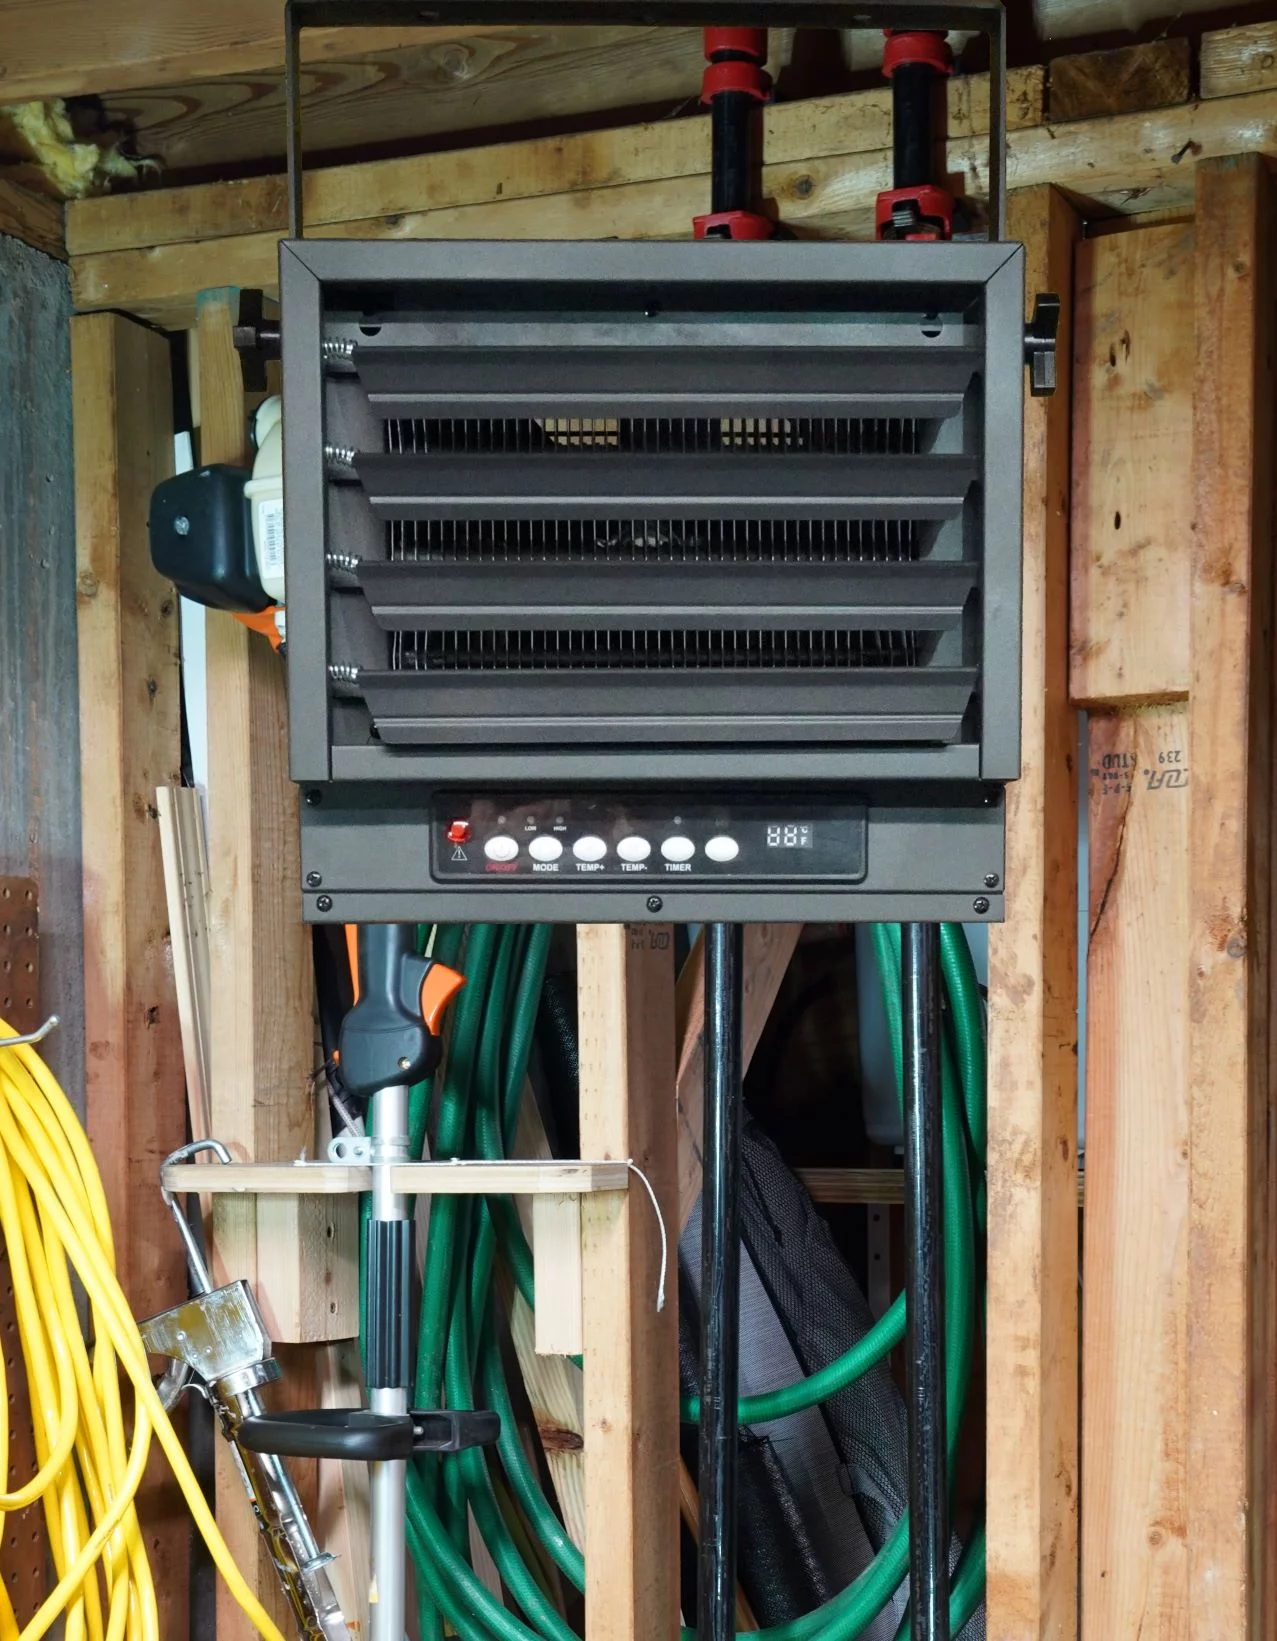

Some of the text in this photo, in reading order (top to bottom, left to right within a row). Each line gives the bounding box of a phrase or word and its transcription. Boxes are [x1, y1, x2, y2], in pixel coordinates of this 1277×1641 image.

[1158, 751, 1182, 764] 239
[532, 863, 560, 873] MODE
[575, 863, 606, 873] TEMP+
[620, 863, 648, 873] TEMP-
[664, 863, 692, 873] TIMER
